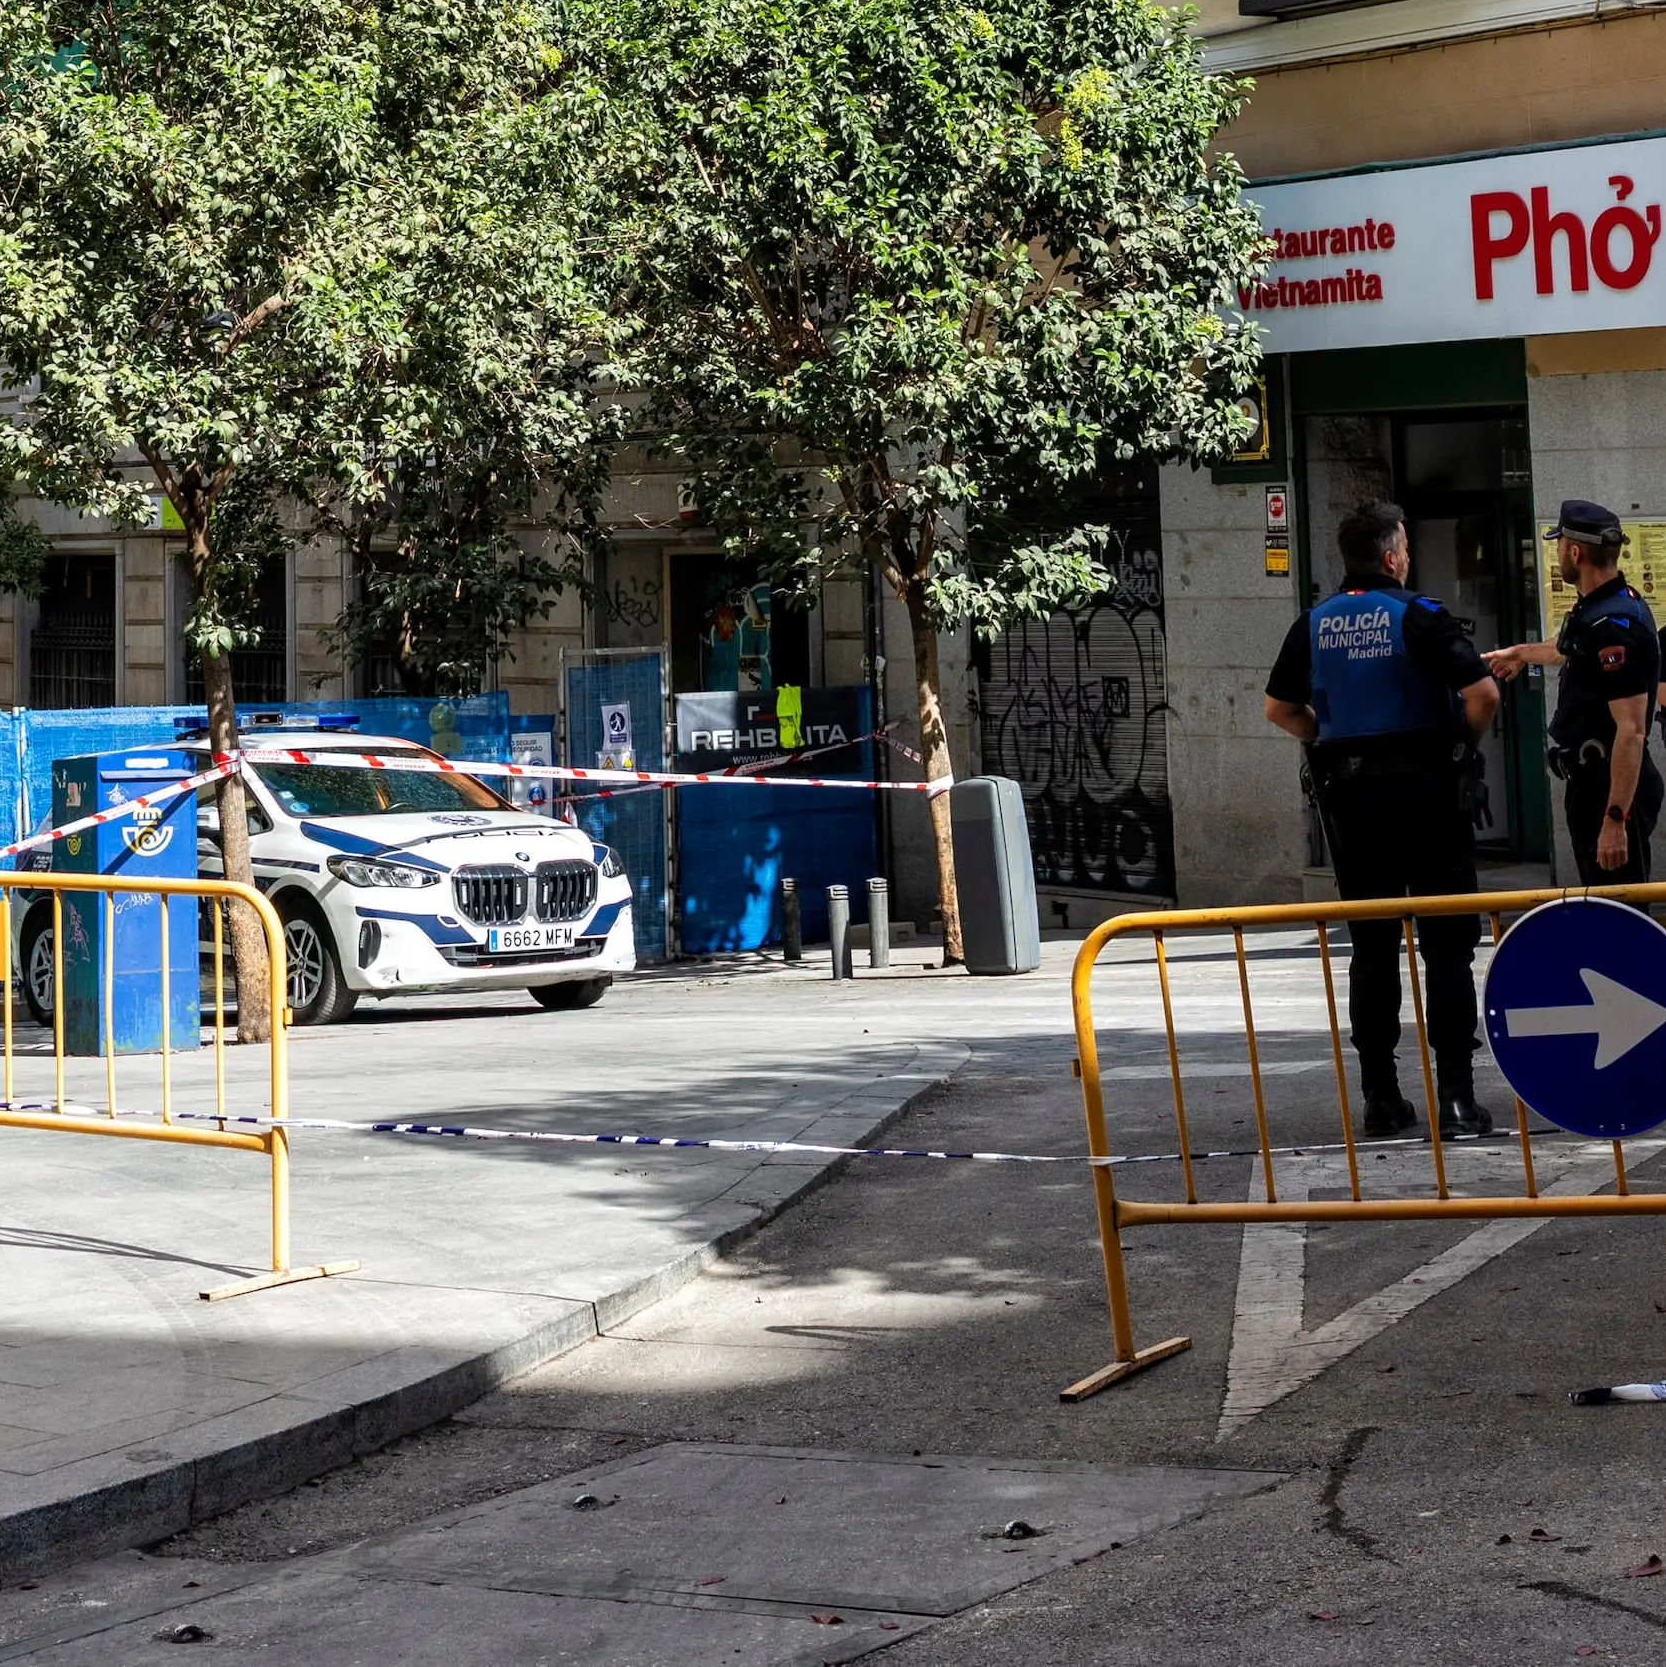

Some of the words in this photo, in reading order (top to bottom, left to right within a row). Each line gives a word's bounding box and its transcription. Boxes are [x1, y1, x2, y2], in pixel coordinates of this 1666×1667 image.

[1318, 606, 1390, 634] POLICÍA
[1318, 629, 1391, 650] MUNICIPAL
[1348, 645, 1392, 660] Madrid
[504, 930, 540, 947] 6662
[546, 928, 572, 945] MFM
